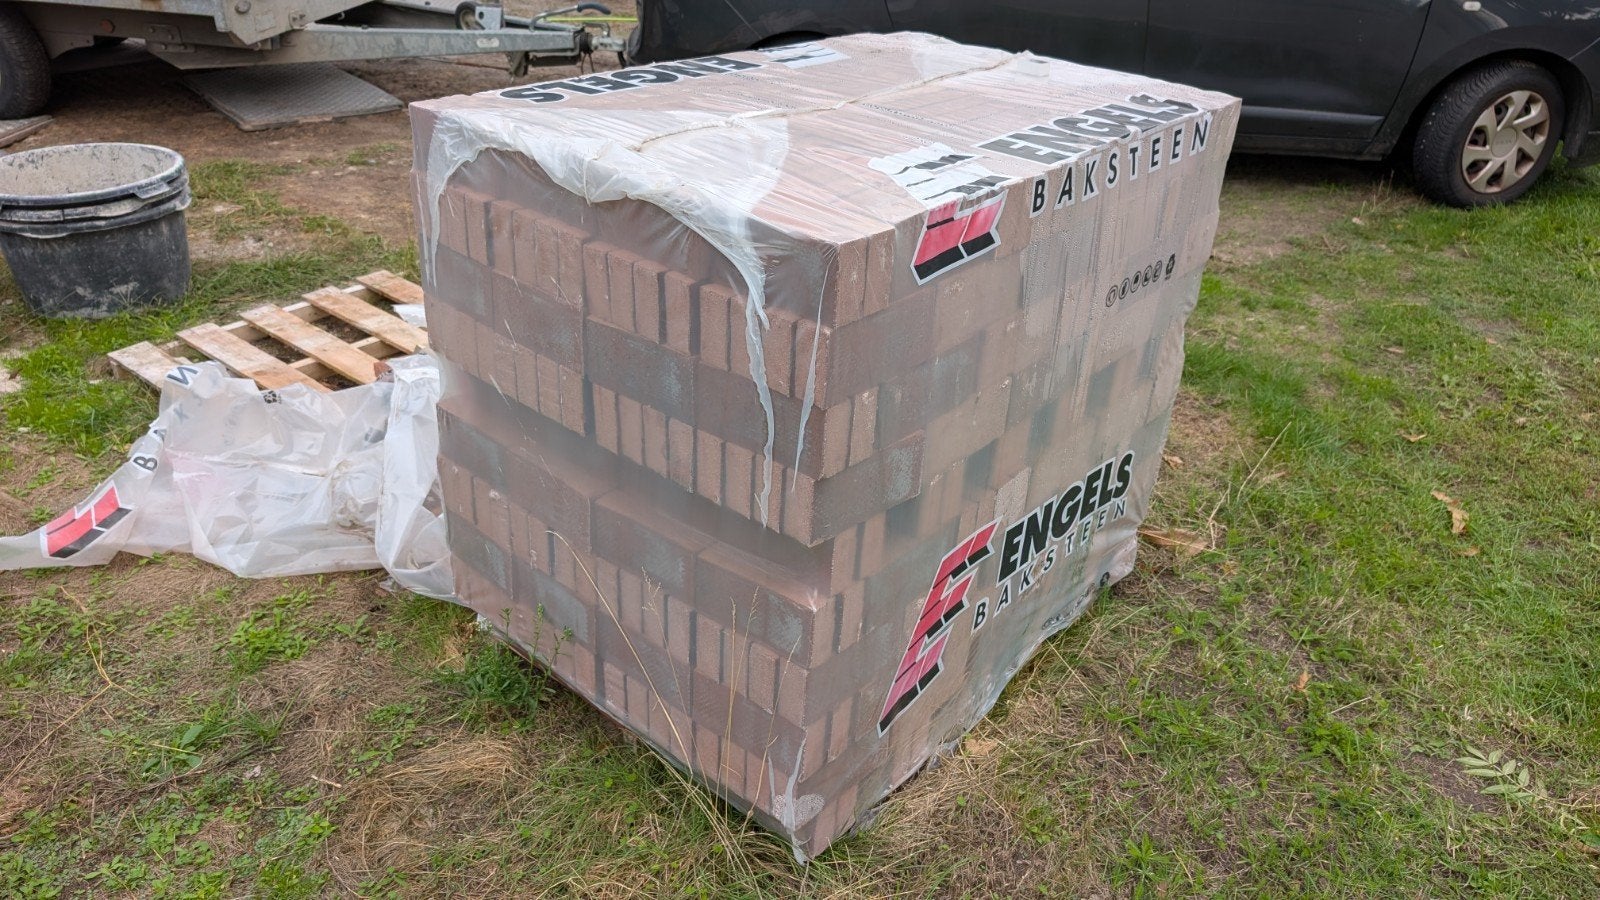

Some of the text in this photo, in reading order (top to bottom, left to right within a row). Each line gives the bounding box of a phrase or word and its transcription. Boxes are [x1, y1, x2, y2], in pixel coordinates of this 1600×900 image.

[500, 57, 763, 103] ENGELS
[978, 94, 1200, 165] ENGELS
[1032, 121, 1208, 213] BAKSTEEN
[998, 452, 1133, 584] ENGELS
[972, 502, 1126, 631] BAKSTEEN
